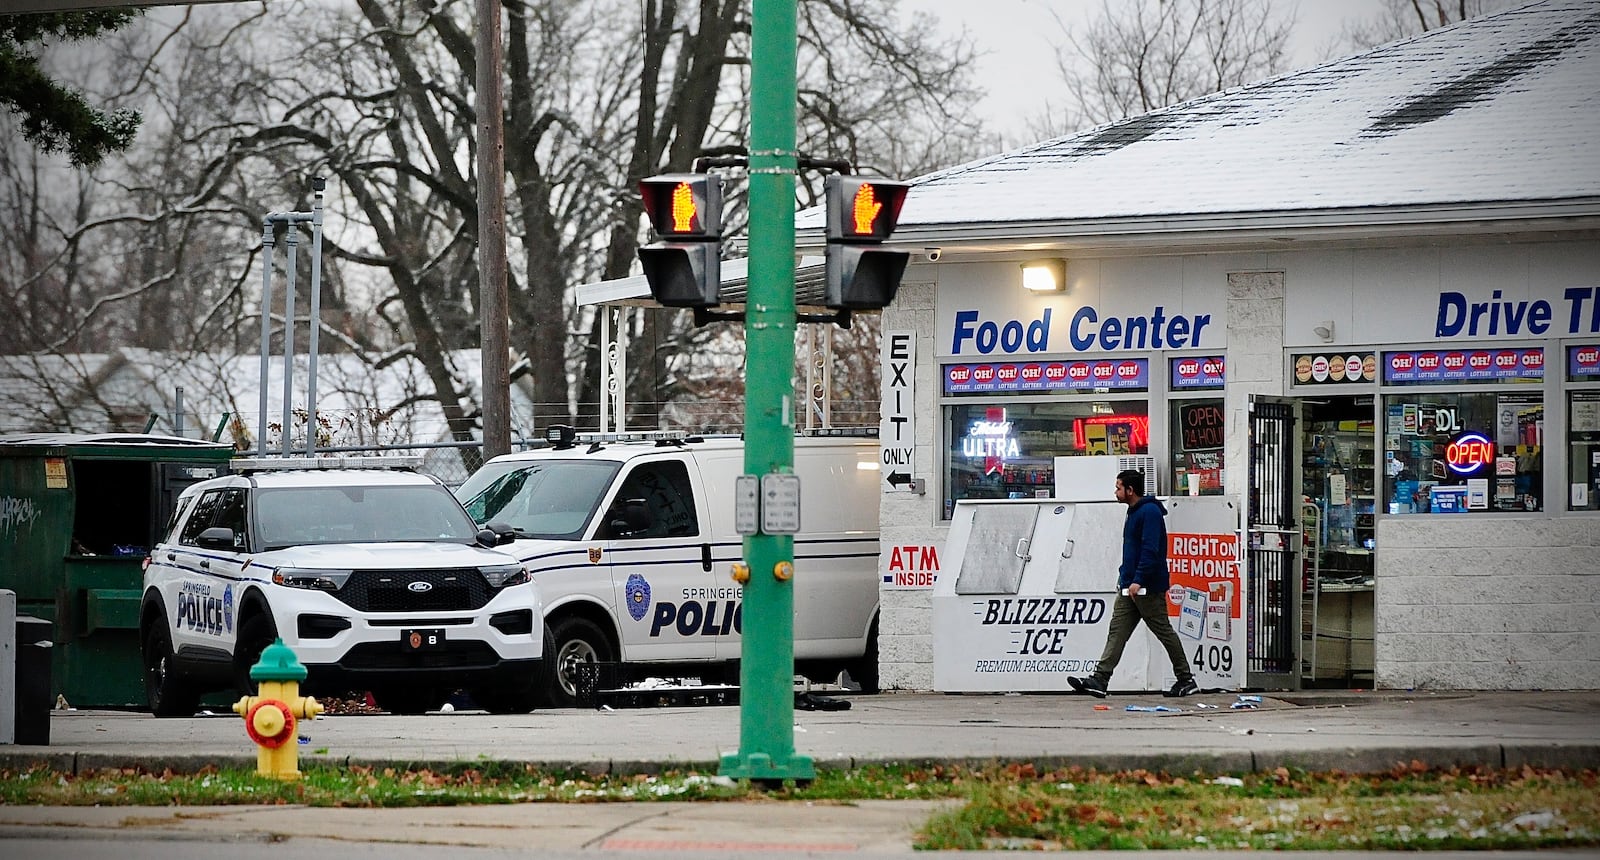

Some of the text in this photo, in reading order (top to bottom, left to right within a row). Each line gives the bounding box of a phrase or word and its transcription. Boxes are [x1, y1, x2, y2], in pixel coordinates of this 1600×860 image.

[1435, 290, 1551, 337] Drive
[952, 306, 1211, 354] Food Center
[1392, 357, 1413, 368] OH!
[1418, 357, 1439, 368] OH!
[1444, 356, 1464, 367] OH!
[1470, 355, 1490, 366] OH!
[1496, 354, 1516, 365] OH!
[1522, 354, 1543, 364] OH!
[1577, 352, 1599, 363] OH!
[974, 368, 993, 379] OH!
[998, 368, 1018, 379] OH!
[1022, 368, 1041, 378] OH!
[1046, 367, 1066, 378] OH!
[1069, 366, 1089, 377] OH!
[1093, 365, 1113, 377] OH!
[1118, 365, 1138, 376] OH!
[1179, 363, 1199, 374] OH!
[950, 369, 969, 380] OH!
[890, 335, 909, 440] EXIT
[1188, 407, 1223, 427] OPEN
[963, 438, 1020, 457] ULTRA
[883, 448, 913, 465] ONLY
[1446, 443, 1492, 464] OPEN
[1173, 537, 1236, 557] RIGHT ON
[889, 546, 940, 571] ATM
[1166, 558, 1188, 573] THE
[895, 572, 933, 586] INSIDE
[177, 592, 223, 636] POLICE
[982, 598, 1106, 625] BLIZZARD
[428, 635, 437, 645] 8
[1019, 629, 1068, 655] ICE
[975, 660, 1022, 673] PREMIUM
[1023, 660, 1080, 673] PACKAGED
